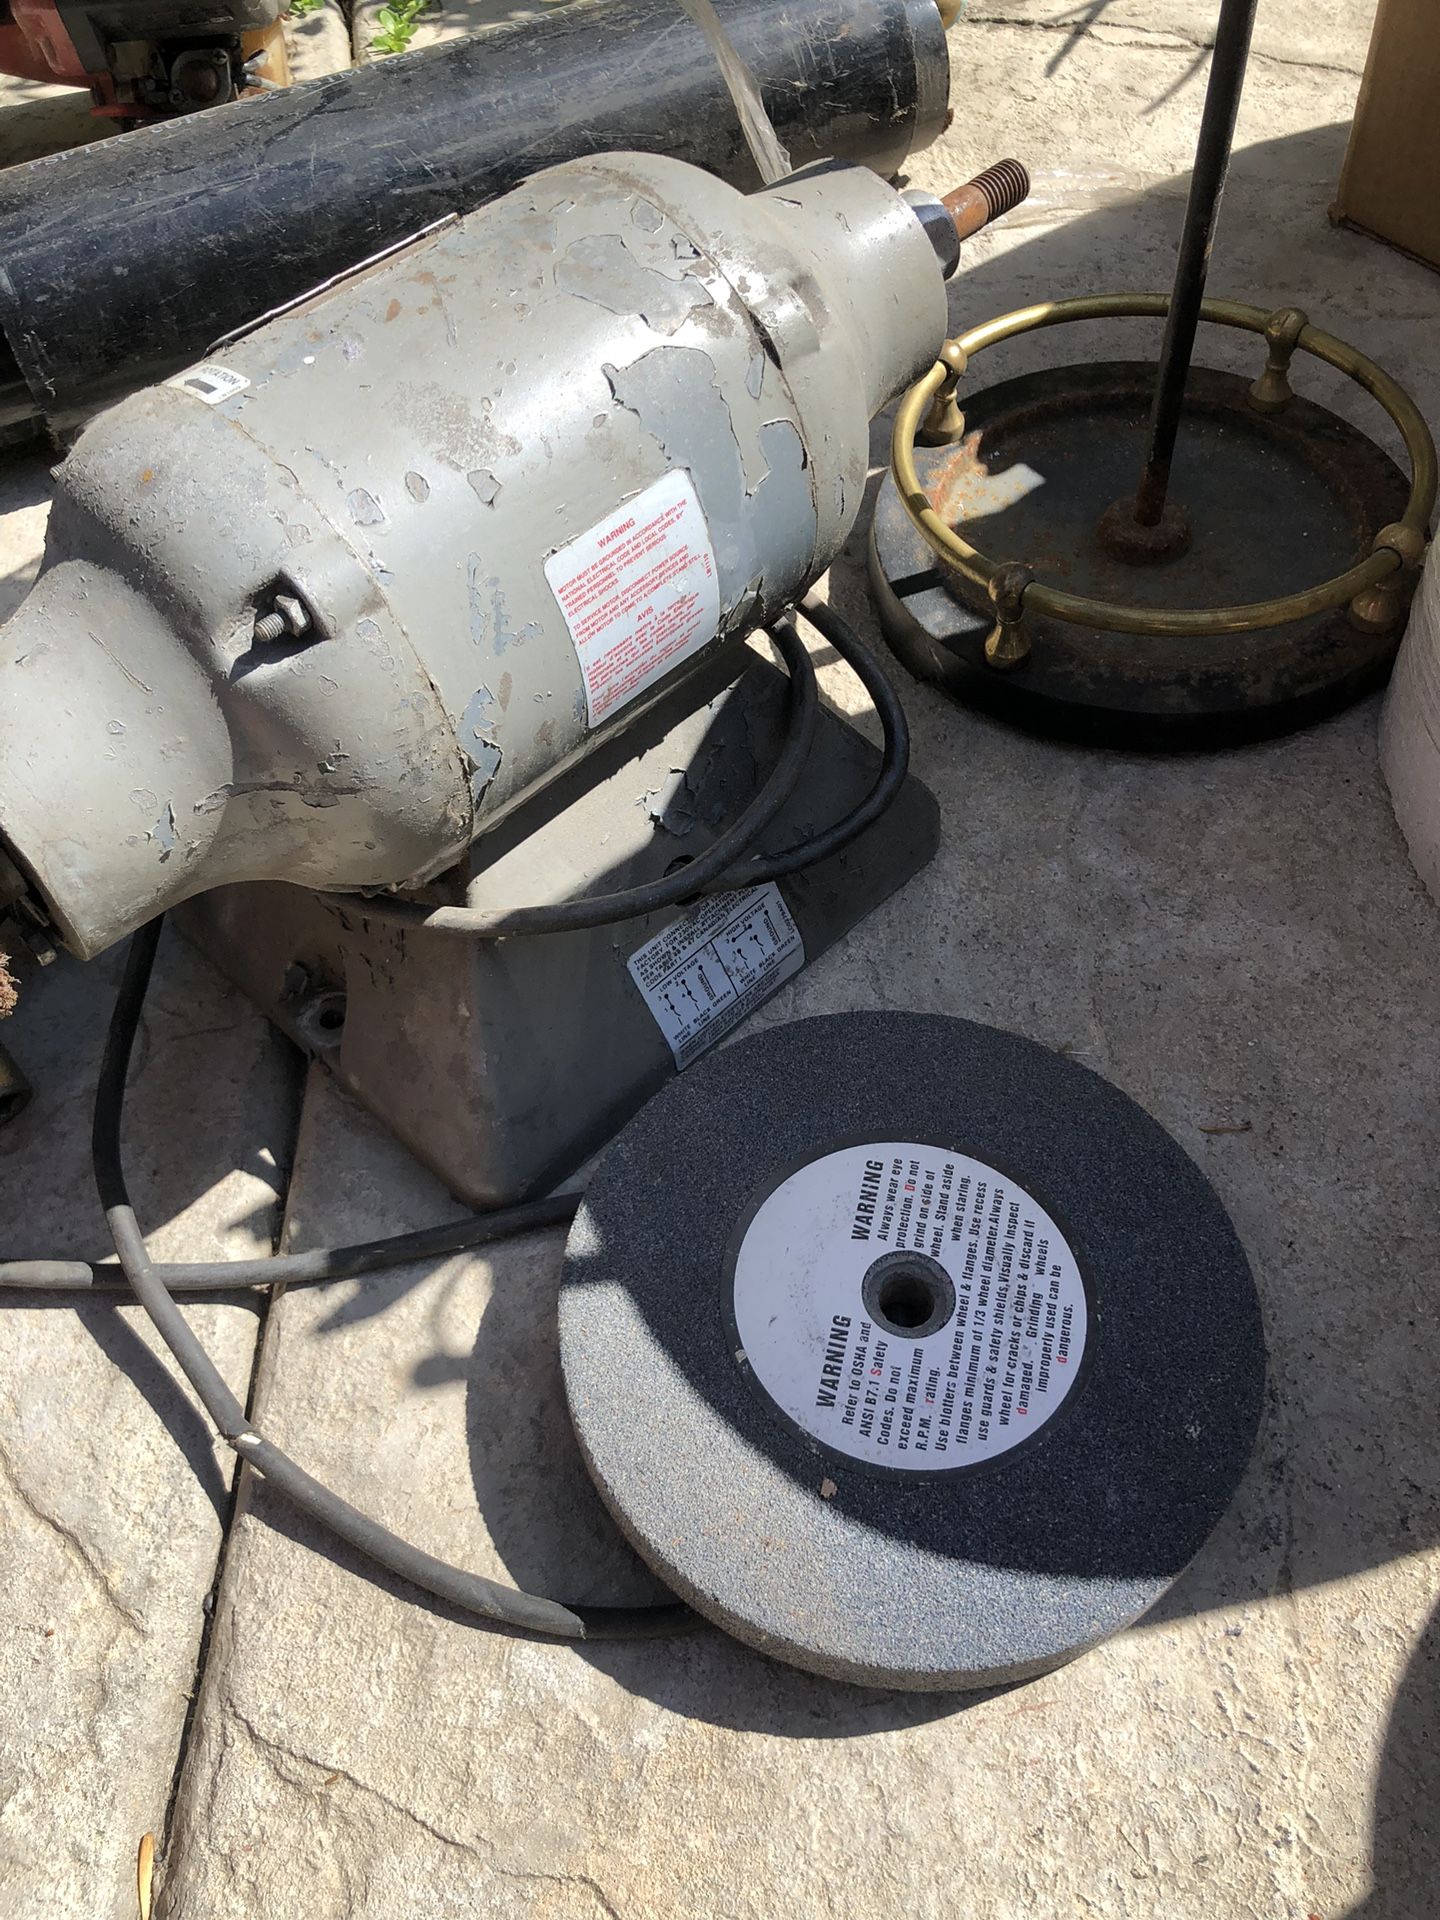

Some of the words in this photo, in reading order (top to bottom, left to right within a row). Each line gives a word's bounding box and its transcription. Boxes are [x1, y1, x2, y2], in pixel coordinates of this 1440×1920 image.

[558, 577, 576, 594] MOTOR
[576, 567, 590, 581] MUST
[590, 561, 598, 571] BE
[598, 541, 626, 565] GROUNDED
[626, 537, 631, 546] IN
[631, 514, 664, 542] ACCORDANCE
[664, 505, 677, 518] WITH
[677, 498, 686, 509] THE
[597, 516, 635, 549] WARNING
[561, 581, 585, 602] NATIONAL
[586, 559, 616, 584] ELECTRICAL
[616, 549, 630, 563] CODE
[630, 541, 641, 552] AND
[641, 529, 657, 545] LOCAL
[565, 591, 586, 610] TRAINED
[586, 569, 616, 594] PERSONNEL
[616, 564, 623, 573] TO
[623, 548, 645, 568] PREVENT
[645, 533, 666, 552] SERIOUS
[573, 622, 580, 631] TO
[581, 606, 601, 625] SERVICE
[620, 571, 650, 596] DISCONNECT
[651, 558, 668, 574] POWER
[669, 543, 688, 561] SOURCE
[575, 624, 590, 638] FROM
[590, 611, 607, 627] MOTOR
[608, 603, 618, 614] AND
[619, 595, 629, 606] ANY
[630, 574, 658, 598] ACCESSORY
[658, 560, 678, 578] DEVICES
[678, 552, 688, 563] AND
[568, 592, 598, 618] ELECTRICAL
[578, 629, 595, 645] ALLOW
[596, 616, 613, 632] MOTOR
[613, 611, 620, 619] TO
[621, 600, 635, 614] COME
[636, 595, 642, 603] TO
[636, 605, 653, 622] AVIS
[726, 922, 740, 936] HIGH
[740, 901, 765, 925] VOLTAGE
[763, 917, 778, 946] GROUND
[659, 979, 672, 992] LOW
[672, 957, 698, 981] VOLTAGE
[739, 967, 756, 984] WHITE
[758, 950, 775, 968] BLACK
[776, 934, 794, 952] GREEN
[697, 972, 714, 1002] GROUND
[672, 1023, 691, 1041] WHITE
[692, 1006, 711, 1024] BLACK
[712, 989, 731, 1007] GREEN
[891, 1157, 903, 1175] eye
[907, 1159, 919, 1175] not
[923, 1169, 935, 1180] of
[940, 1162, 954, 1190] aside
[850, 1159, 883, 1241] WARNING
[886, 1177, 899, 1202] wear
[904, 1177, 917, 1191] Do
[919, 1182, 933, 1205] side
[954, 1174, 971, 1212] staring.
[972, 1180, 987, 1214] recess
[876, 1204, 895, 1241] Always
[894, 1193, 914, 1248] protection.
[918, 1206, 929, 1219] on
[934, 1191, 949, 1221] Stand
[1003, 1201, 1021, 1239] inspect
[912, 1221, 927, 1248] grind
[928, 1223, 944, 1257] wheel.
[950, 1214, 964, 1241] when
[967, 1216, 981, 1235] Use
[1023, 1219, 1036, 1228] if
[960, 1237, 979, 1280] flanges.
[1017, 1229, 1035, 1269] discard
[1032, 1237, 1050, 1276] wheels
[1016, 1272, 1027, 1280] &
[1049, 1263, 1062, 1277] be
[959, 1283, 971, 1291] &
[975, 1274, 991, 1306] wheel
[1011, 1283, 1028, 1313] chips
[1048, 1280, 1060, 1300] can
[953, 1294, 970, 1326] wheel
[972, 1309, 986, 1327] 1/3
[1011, 1314, 1023, 1328] or
[1024, 1291, 1044, 1338] Grinding
[1042, 1302, 1057, 1328] used
[858, 1321, 871, 1342] and
[970, 1329, 983, 1341] of
[986, 1327, 1003, 1362] safety
[1054, 1302, 1076, 1363] dangerous.
[815, 1314, 851, 1407] WARNING
[851, 1344, 867, 1376] OSHA
[869, 1339, 888, 1376] Safety
[945, 1329, 965, 1378] between
[1004, 1330, 1022, 1369] cracks
[1033, 1331, 1056, 1392] improperly
[848, 1379, 861, 1390] to
[887, 1365, 901, 1384] not
[903, 1347, 924, 1403] maximum
[922, 1365, 941, 1404] rating.
[961, 1344, 982, 1397] minimum
[984, 1364, 997, 1374] &
[1001, 1370, 1015, 1387] for
[865, 1379, 879, 1405] B7.1
[884, 1387, 897, 1402] Do
[938, 1380, 957, 1425] blotters
[979, 1376, 997, 1416] guards
[1013, 1358, 1035, 1415] damaged.
[841, 1392, 858, 1425] Refer
[859, 1408, 874, 1437] ANSI
[954, 1400, 974, 1444] flanges
[996, 1390, 1014, 1426] wheel
[876, 1405, 894, 1445] Codes.
[896, 1406, 914, 1449] exceed
[915, 1413, 932, 1450] R.P.M.
[934, 1428, 949, 1451] Use
[976, 1419, 989, 1440] use
